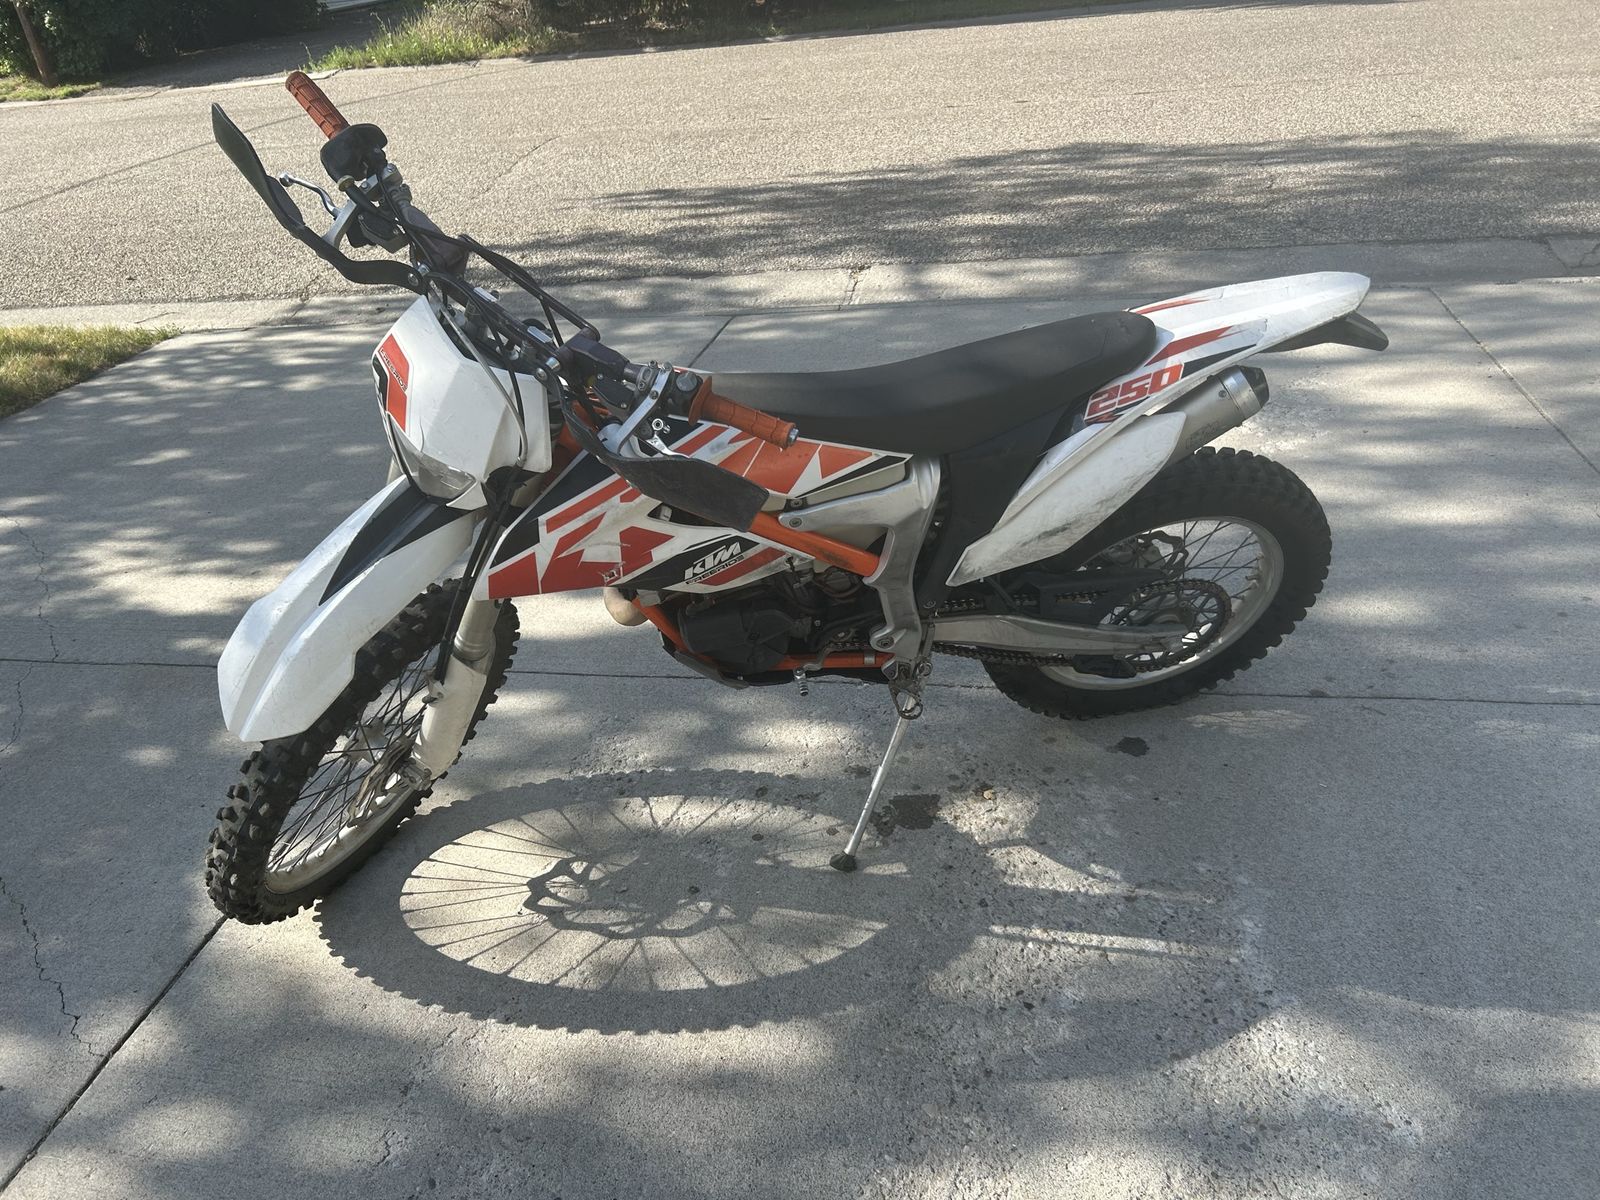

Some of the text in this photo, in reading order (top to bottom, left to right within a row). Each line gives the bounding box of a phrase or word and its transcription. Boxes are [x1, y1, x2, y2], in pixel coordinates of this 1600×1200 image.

[1086, 363, 1184, 417] 250
[684, 541, 741, 580] KTM
[685, 554, 745, 584] FREERIDE
